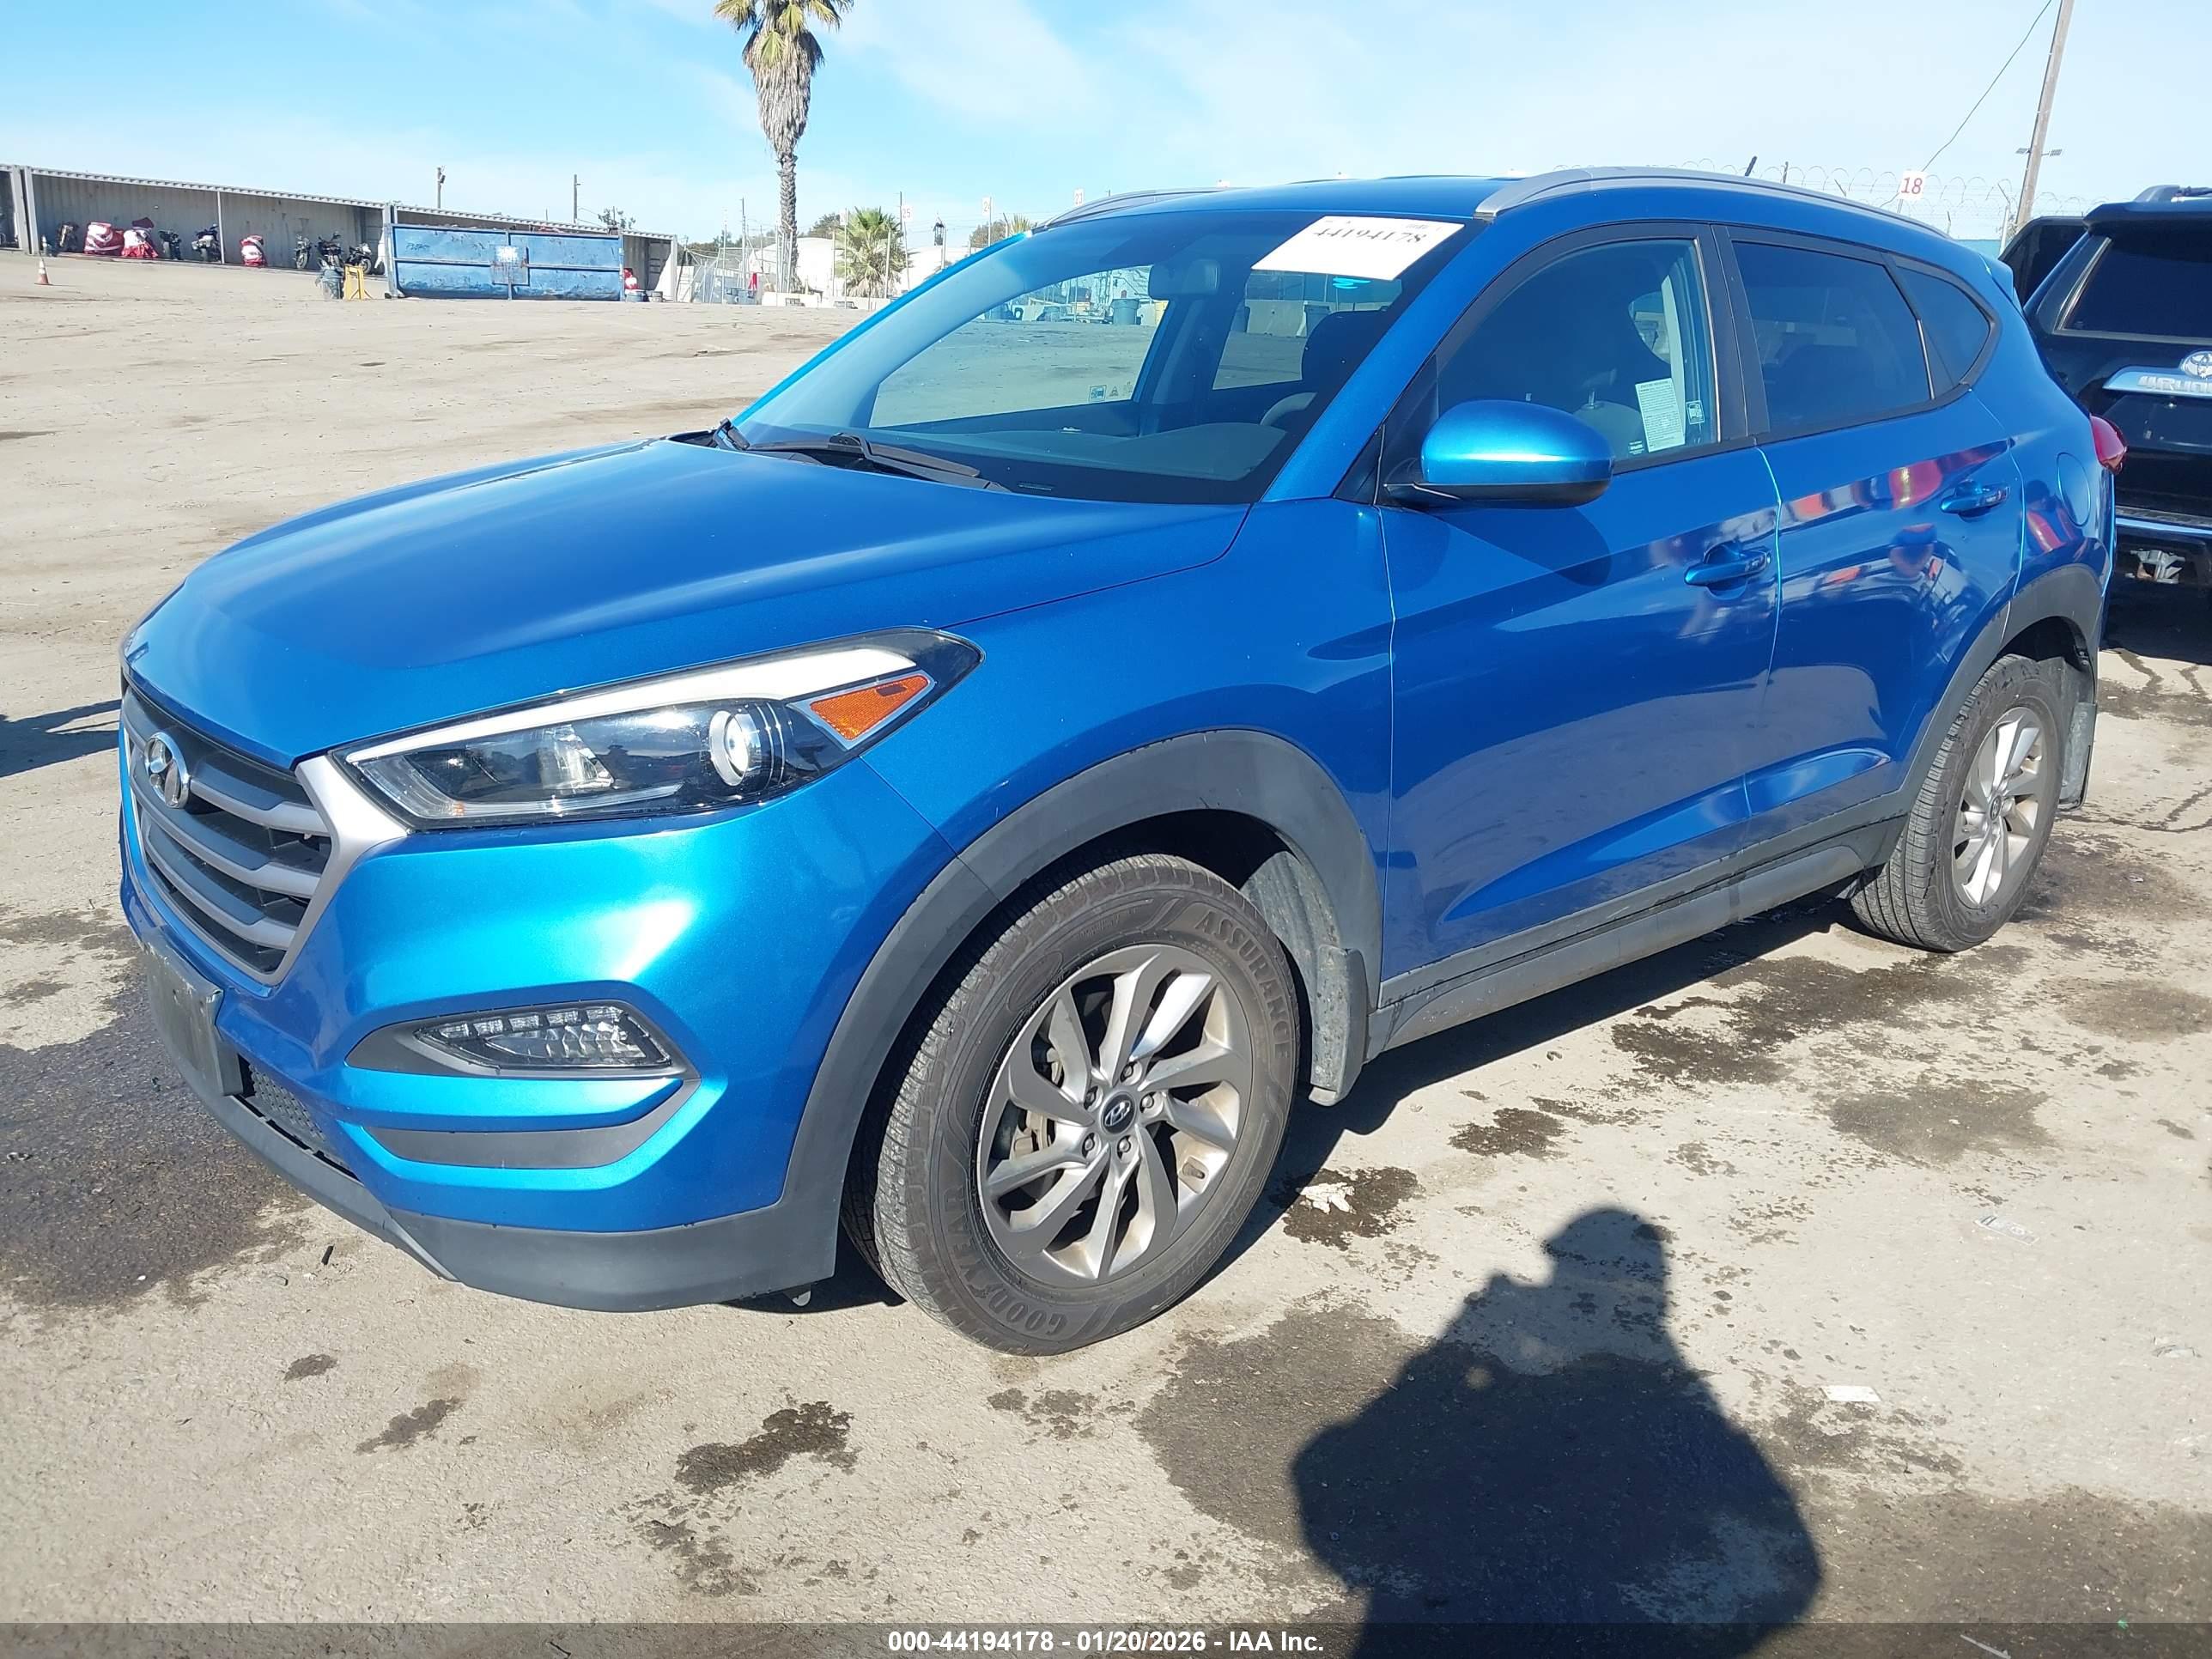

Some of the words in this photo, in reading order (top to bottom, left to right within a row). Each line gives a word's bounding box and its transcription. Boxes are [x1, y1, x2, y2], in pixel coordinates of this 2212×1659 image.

[1900, 177, 1923, 195] 18
[902, 208, 911, 219] 25
[1313, 228, 1427, 242] 44194178
[1194, 910, 1291, 1060] ASSURANCE
[943, 1185, 1068, 1337] GOODYEAR
